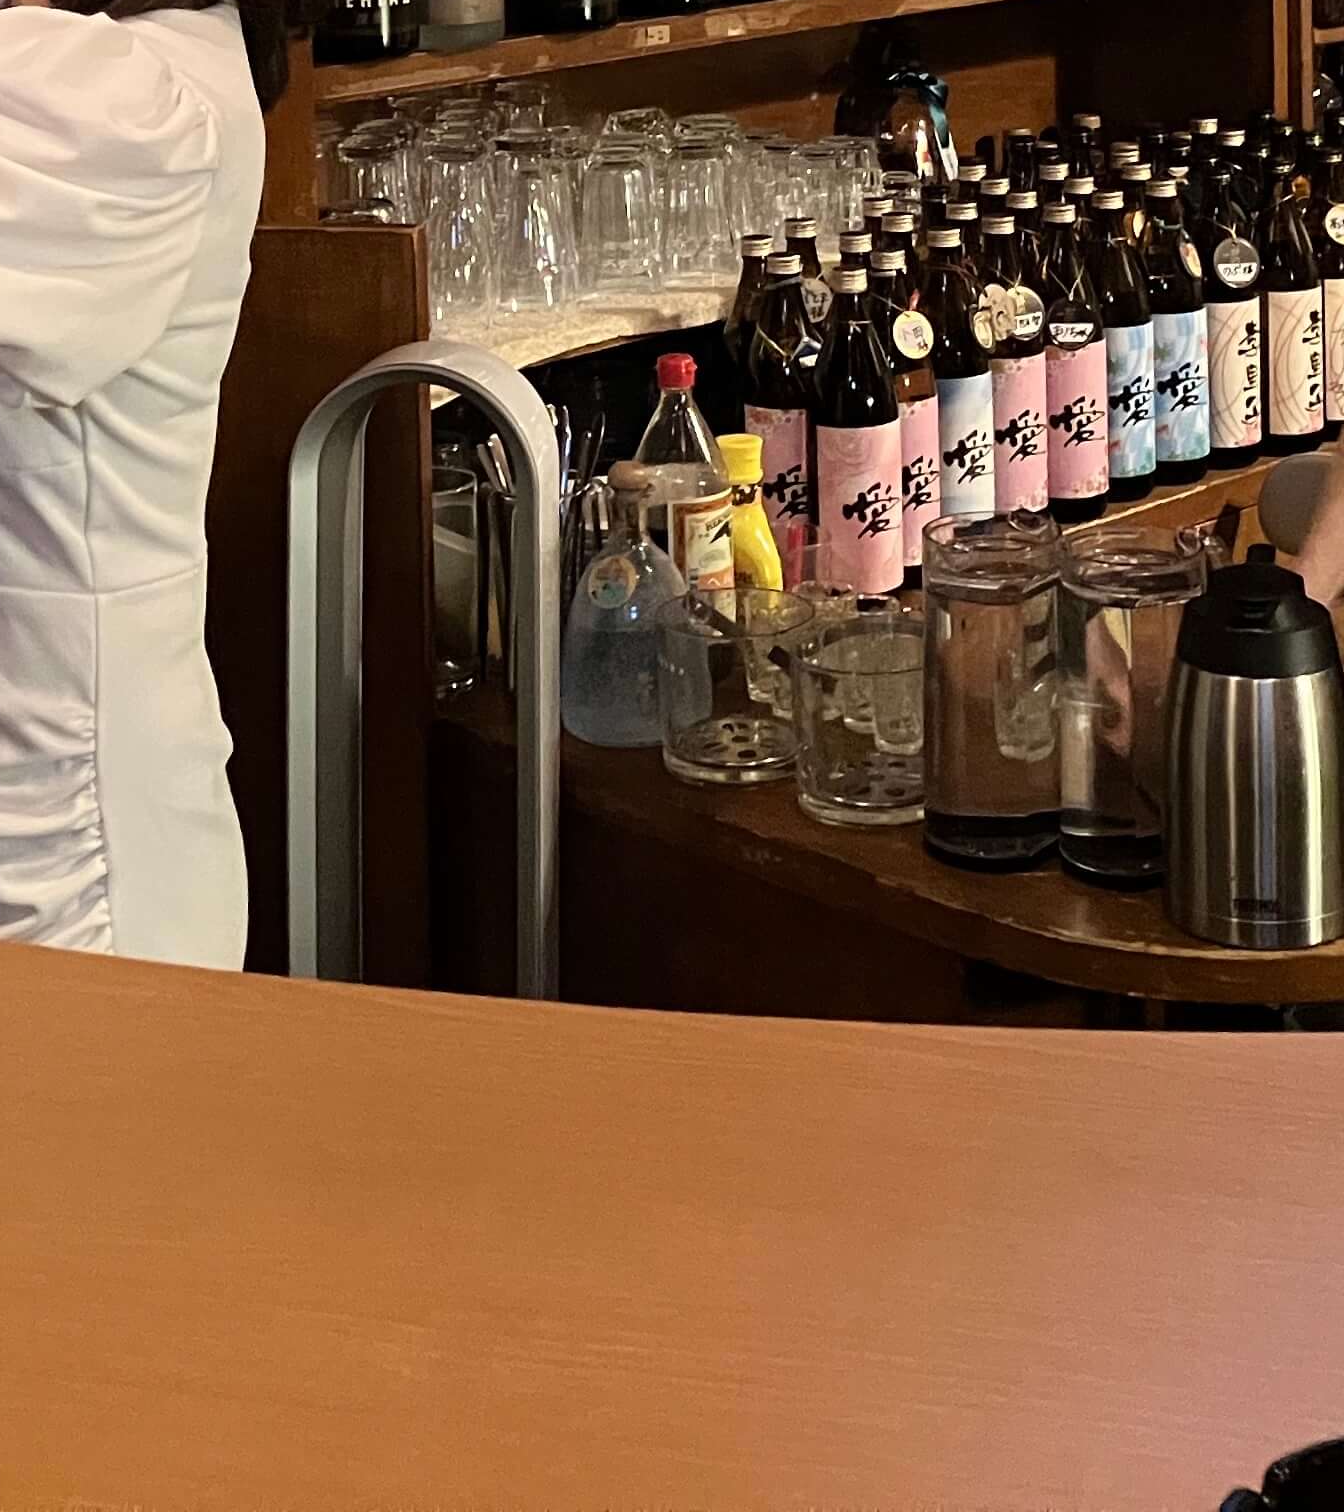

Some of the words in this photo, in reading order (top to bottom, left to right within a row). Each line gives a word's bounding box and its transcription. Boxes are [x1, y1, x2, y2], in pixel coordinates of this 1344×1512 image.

[1109, 375, 1155, 427] 愛
[1158, 362, 1207, 412] 愛
[994, 409, 1047, 463] 愛
[1049, 396, 1106, 448] 愛
[943, 429, 993, 486] 愛
[843, 482, 900, 540] 愛
